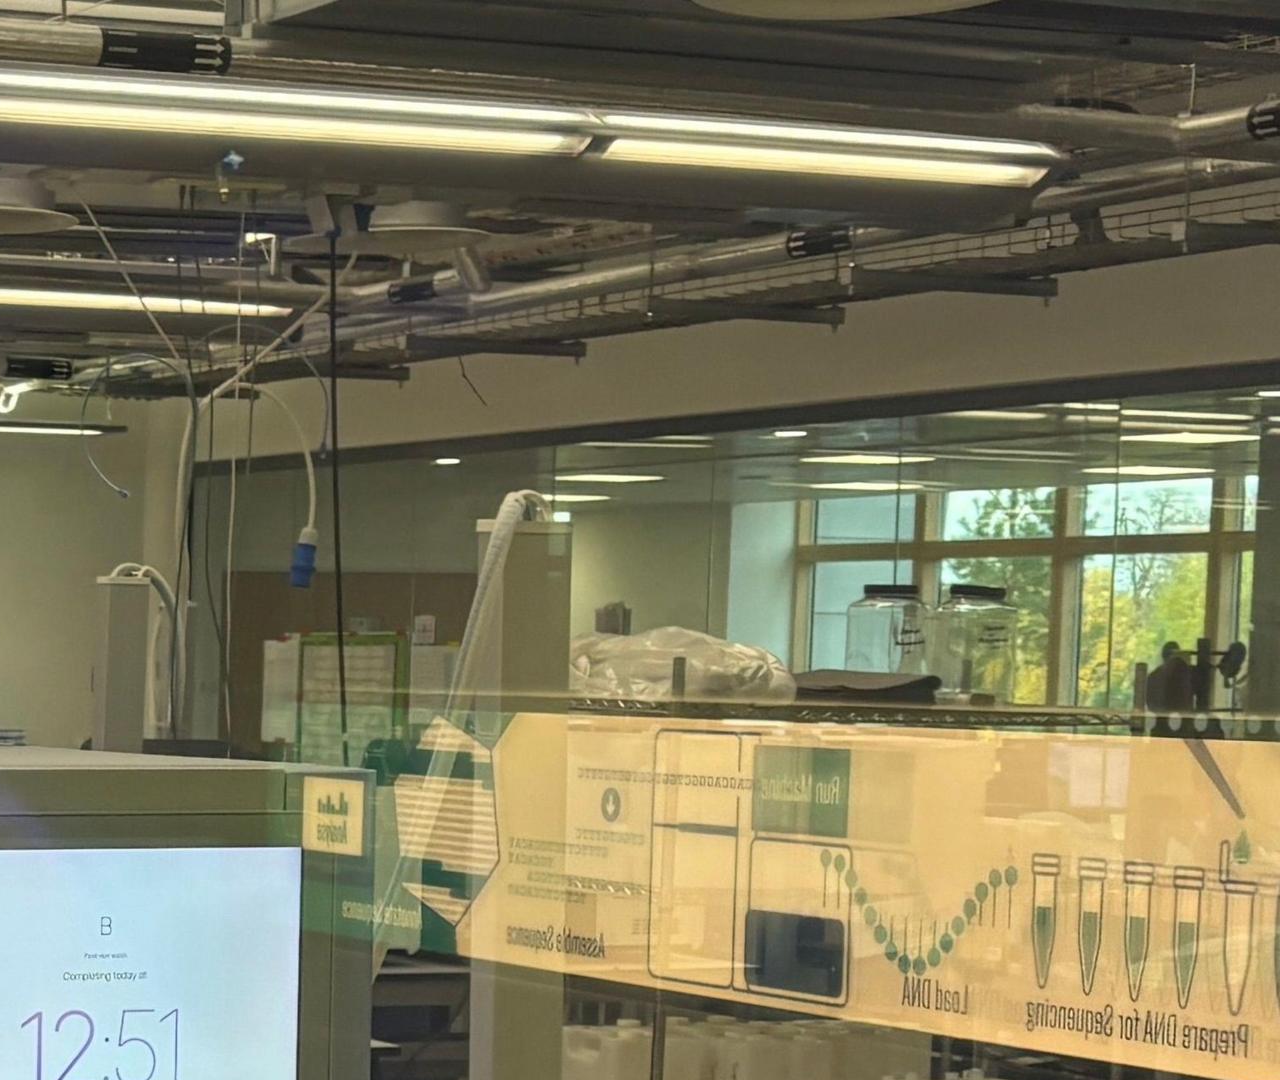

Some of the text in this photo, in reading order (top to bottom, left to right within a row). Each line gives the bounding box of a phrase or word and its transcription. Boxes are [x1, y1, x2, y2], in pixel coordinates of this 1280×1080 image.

[100, 916, 112, 936] B
[63, 971, 111, 982] Completing
[113, 971, 137, 981] today
